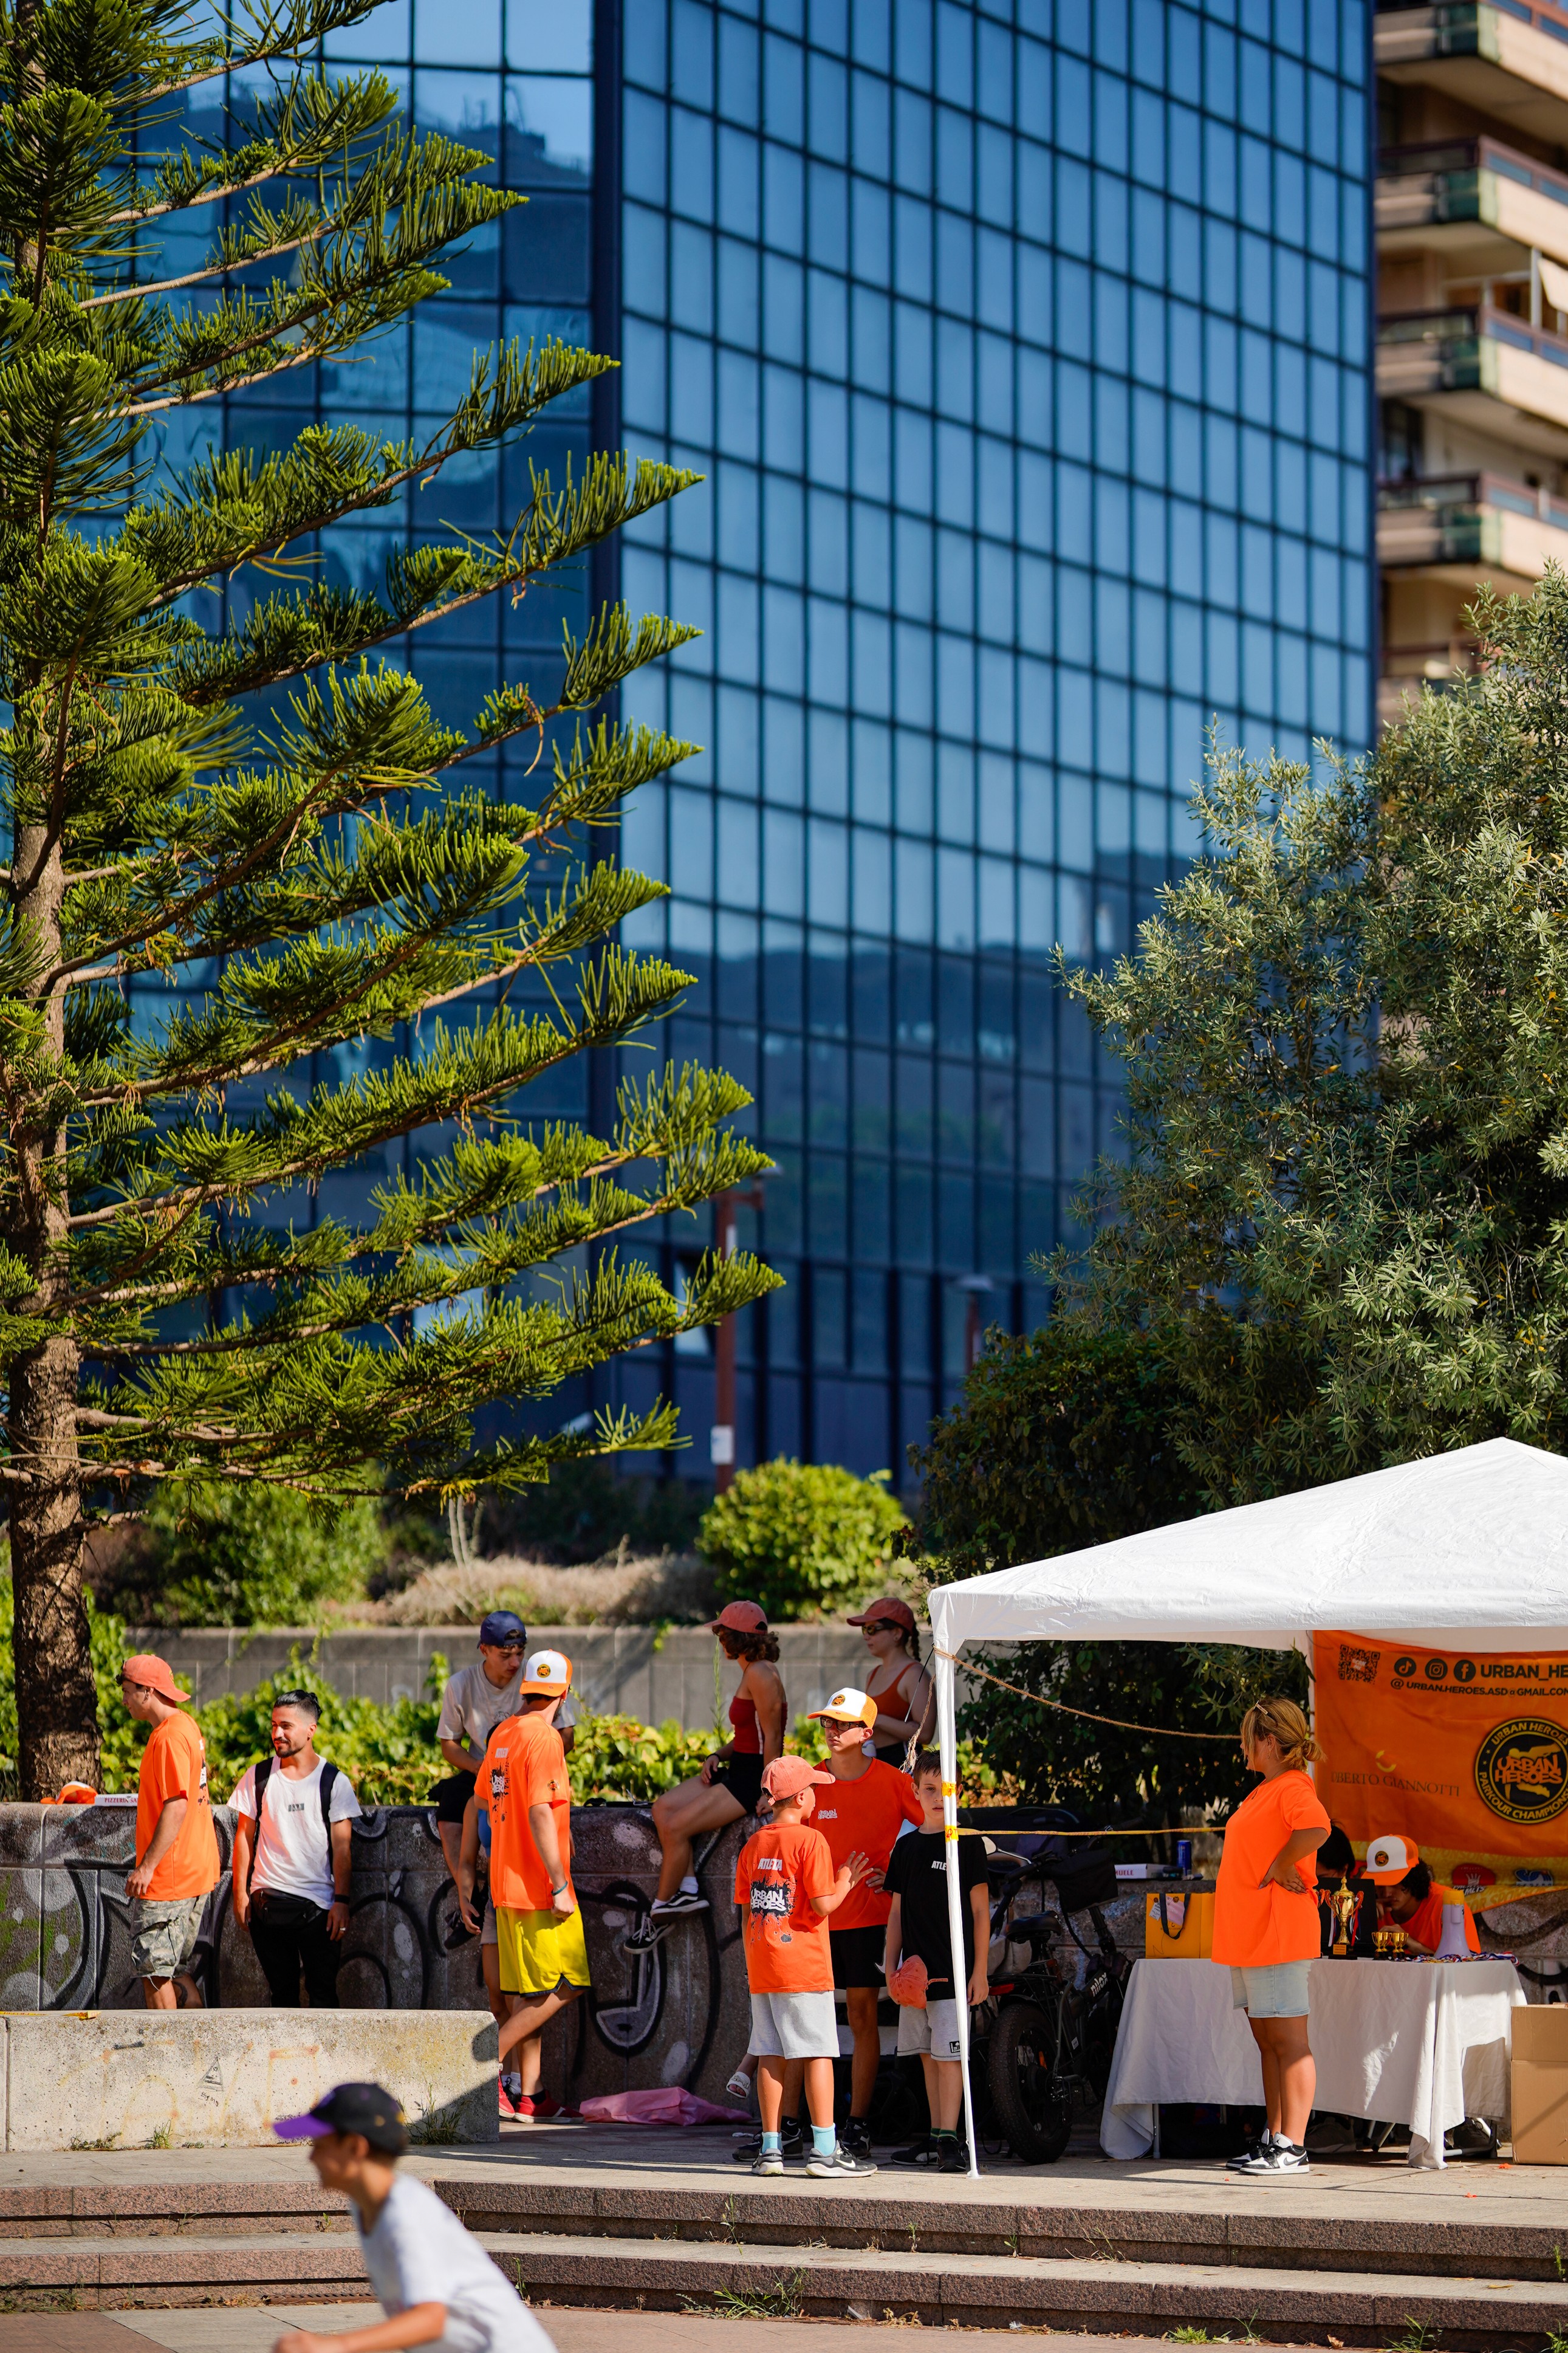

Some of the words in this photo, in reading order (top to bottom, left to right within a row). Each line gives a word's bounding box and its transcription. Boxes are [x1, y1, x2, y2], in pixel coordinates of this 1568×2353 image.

[1481, 1664, 1568, 1681] URBAN_HE
[1491, 1722, 1527, 1745] URBAN
[1497, 1754, 1561, 1776] URBAN
[1494, 1769, 1563, 1784] HEROES
[1383, 1775, 1460, 1797] GIANNOTTI
[1479, 1771, 1513, 1815] PARKOUR
[757, 1858, 782, 1871] ATLETA
[750, 1898, 787, 1911] HEROES
[751, 1888, 785, 1906] URBAN
